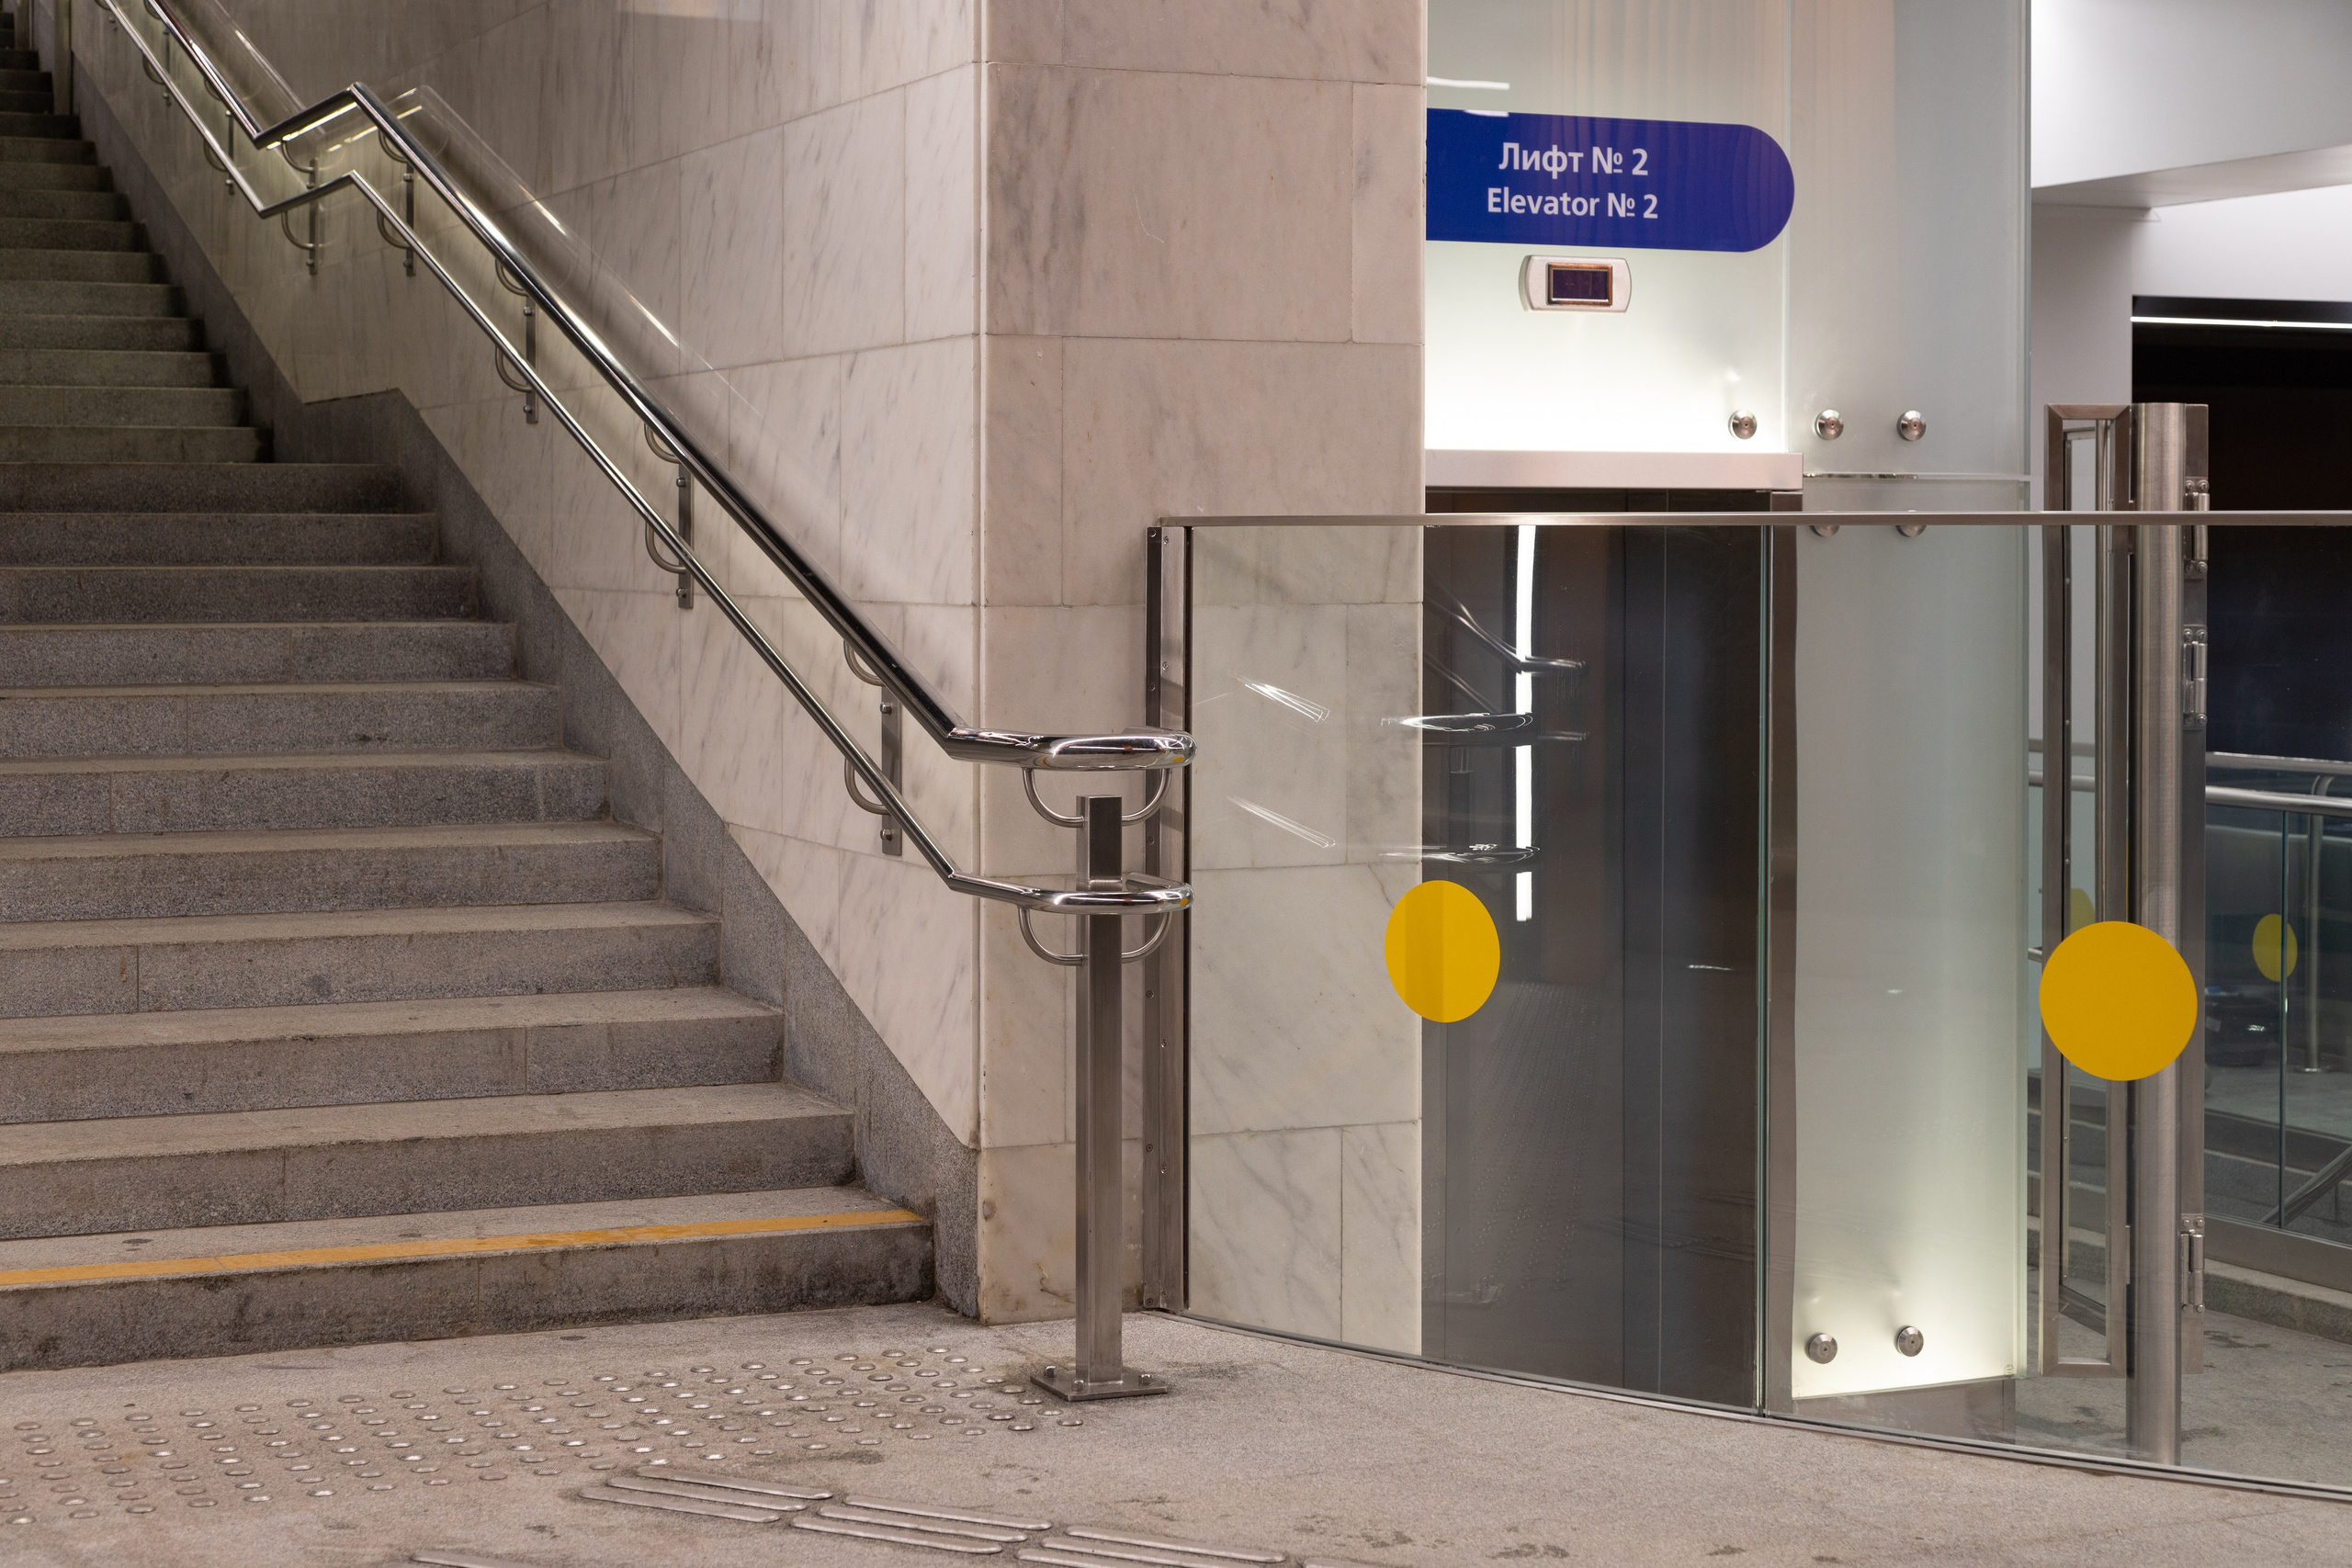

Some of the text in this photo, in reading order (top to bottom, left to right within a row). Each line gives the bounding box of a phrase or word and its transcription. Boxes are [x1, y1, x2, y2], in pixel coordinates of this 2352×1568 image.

[1498, 142, 1649, 180] Лифт № 2
[1487, 186, 1659, 220] Elevator № 2
